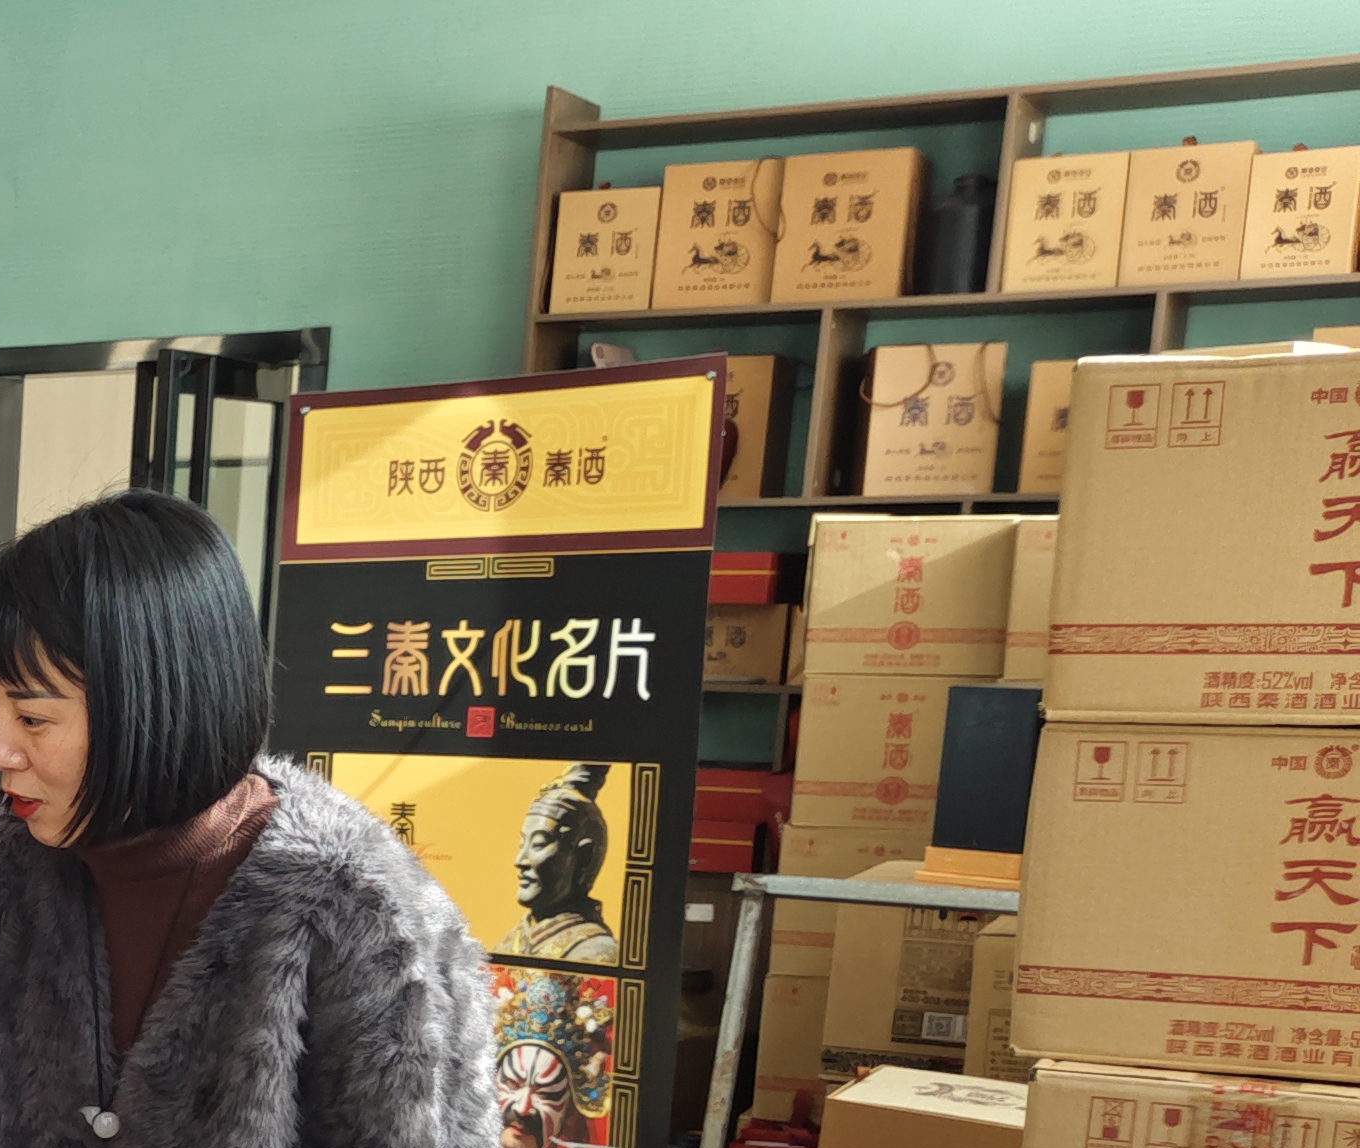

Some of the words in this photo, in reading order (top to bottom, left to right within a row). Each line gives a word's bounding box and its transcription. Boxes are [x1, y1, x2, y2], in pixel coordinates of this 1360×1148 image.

[387, 457, 446, 497] 陕西
[543, 446, 608, 488] 秦酒
[323, 616, 657, 700] 三秦文化名片
